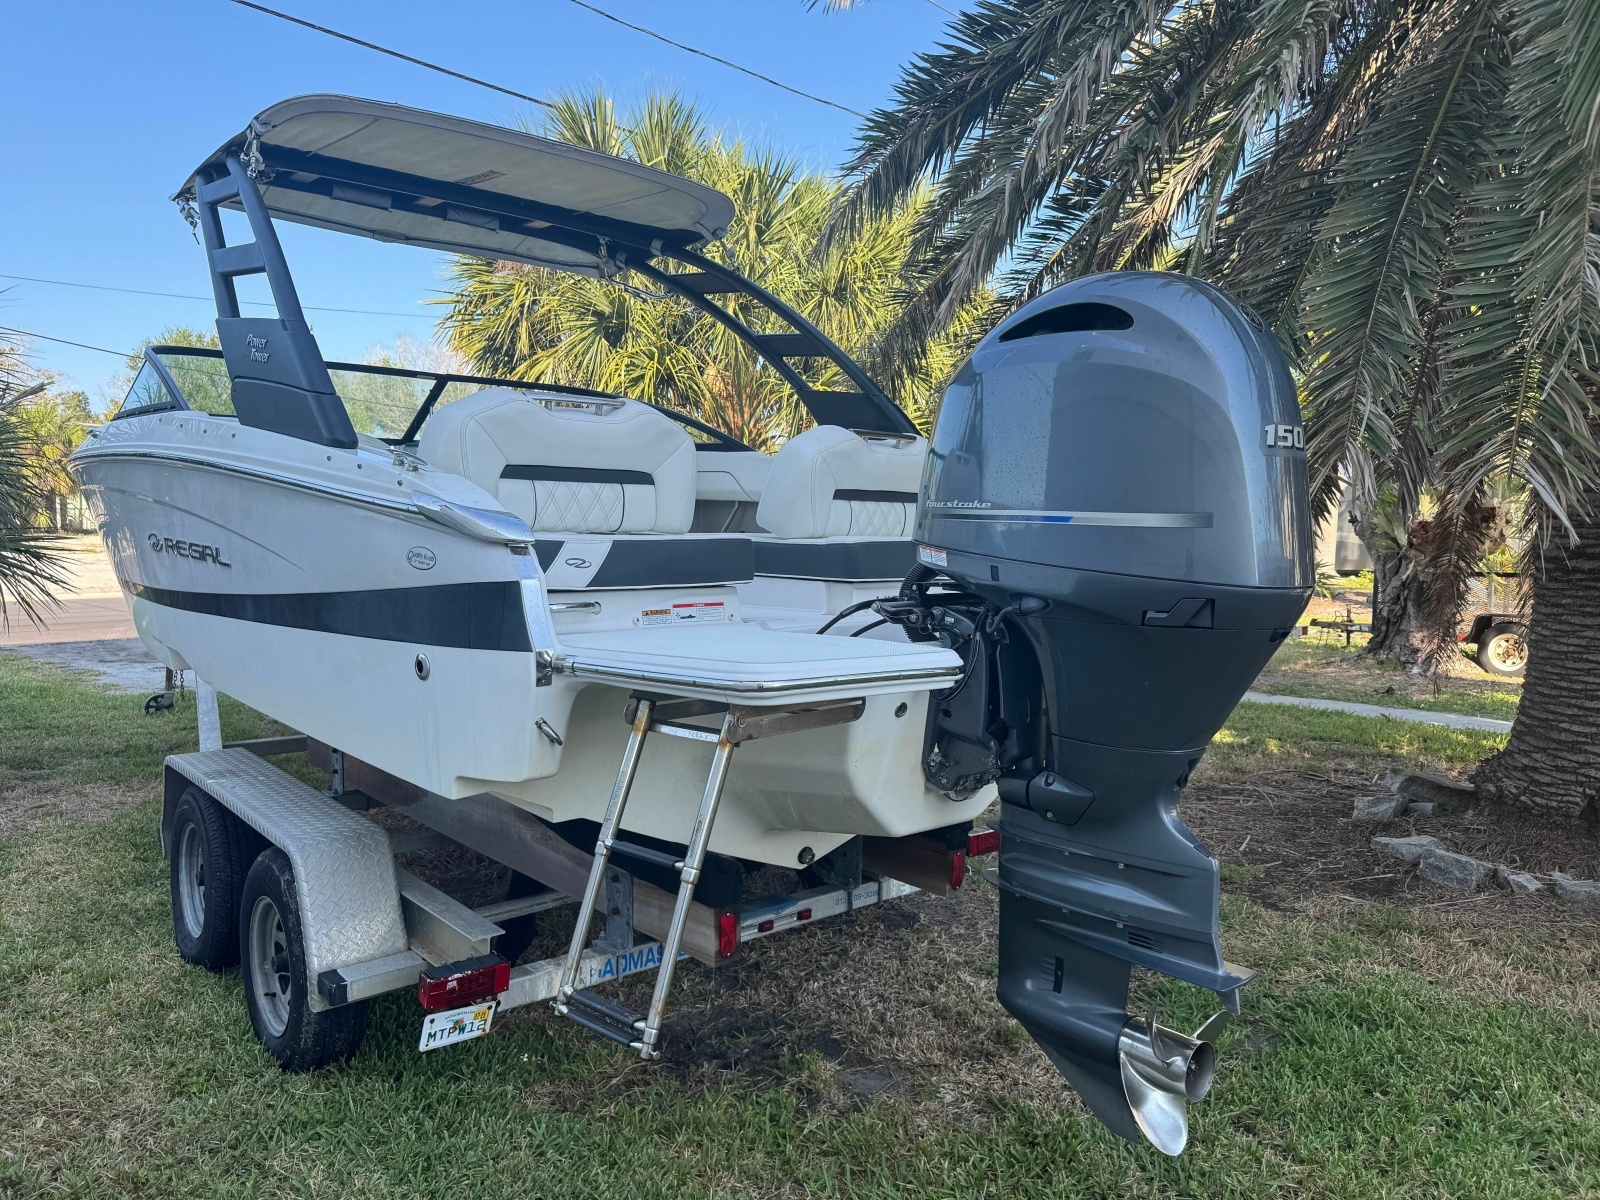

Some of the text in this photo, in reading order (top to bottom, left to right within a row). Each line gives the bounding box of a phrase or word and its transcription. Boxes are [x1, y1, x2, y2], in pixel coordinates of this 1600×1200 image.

[246, 333, 268, 349] Power
[250, 348, 270, 363] Tower
[1265, 424, 1304, 449] 150
[164, 537, 232, 568] REGAL
